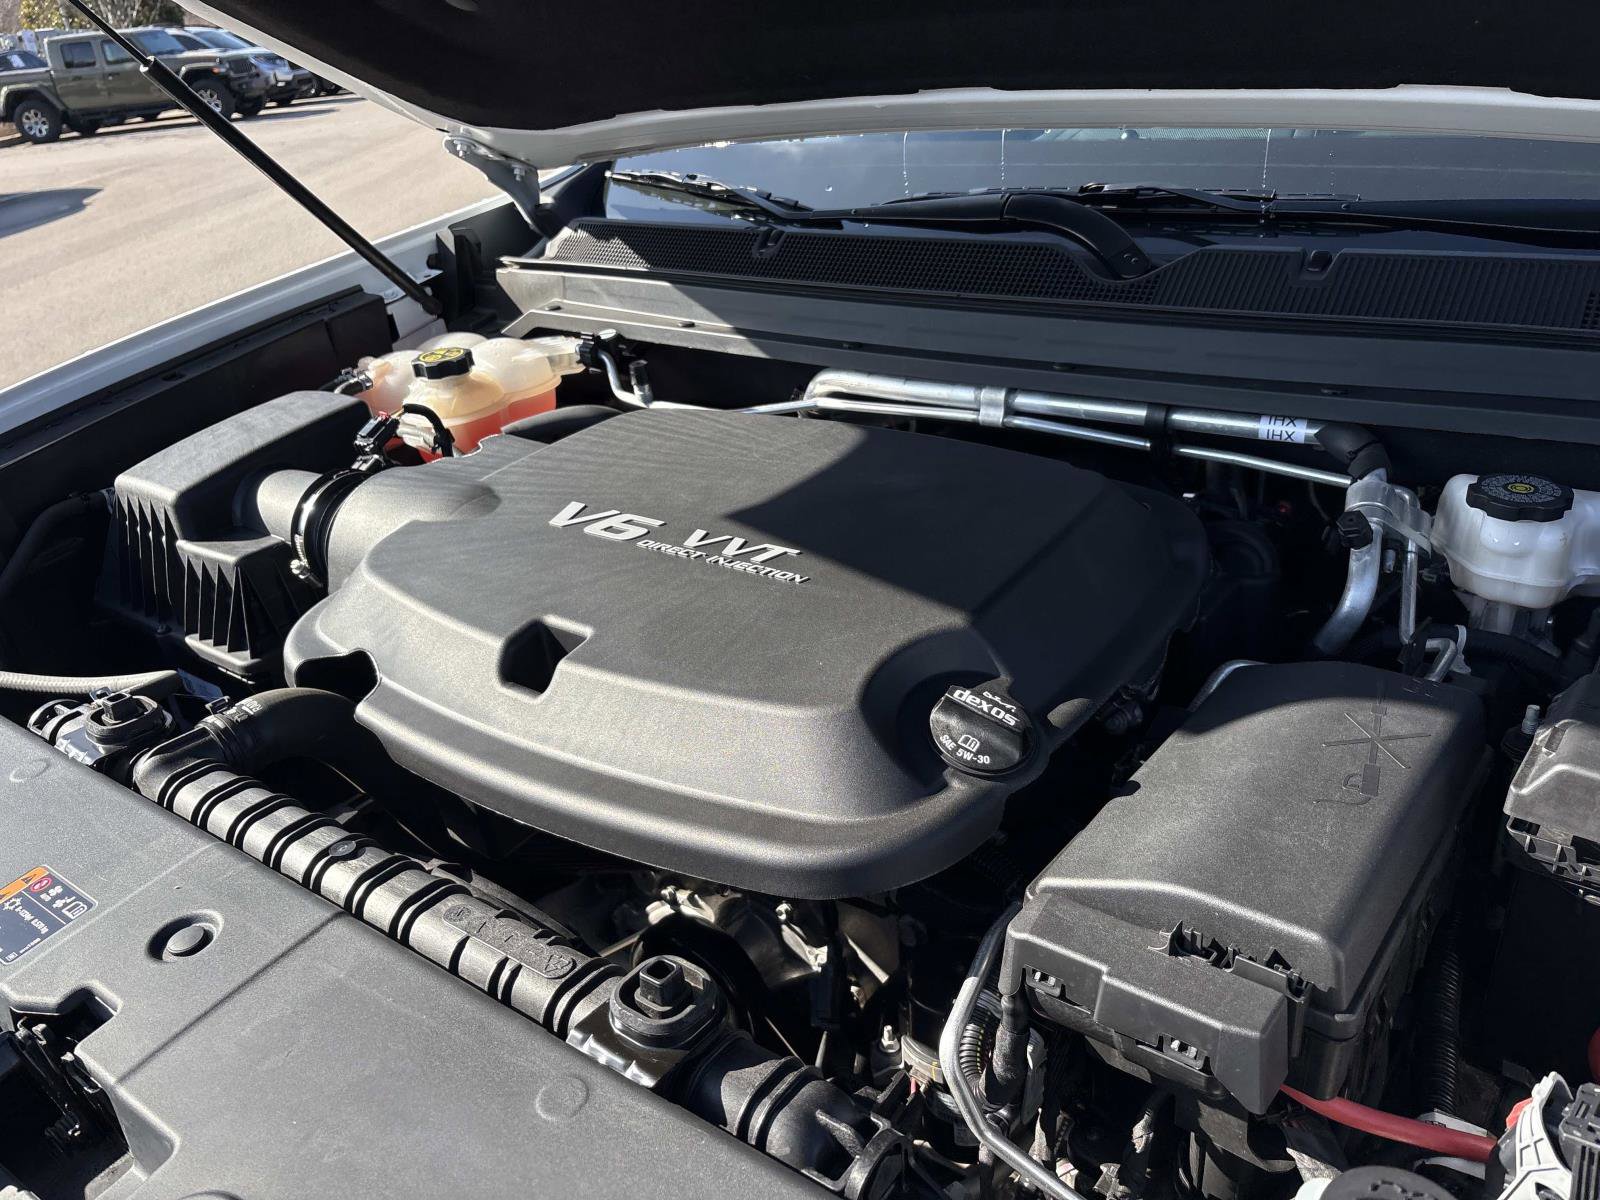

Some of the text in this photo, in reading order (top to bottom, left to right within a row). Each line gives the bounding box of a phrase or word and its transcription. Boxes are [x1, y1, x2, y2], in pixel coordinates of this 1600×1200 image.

[1267, 429, 1296, 442] IHX
[548, 501, 802, 564] V6 VVT
[636, 539, 811, 585] DIRECT INJECTION
[952, 689, 1021, 727] dexos
[940, 734, 991, 764] SAE 5W-30
